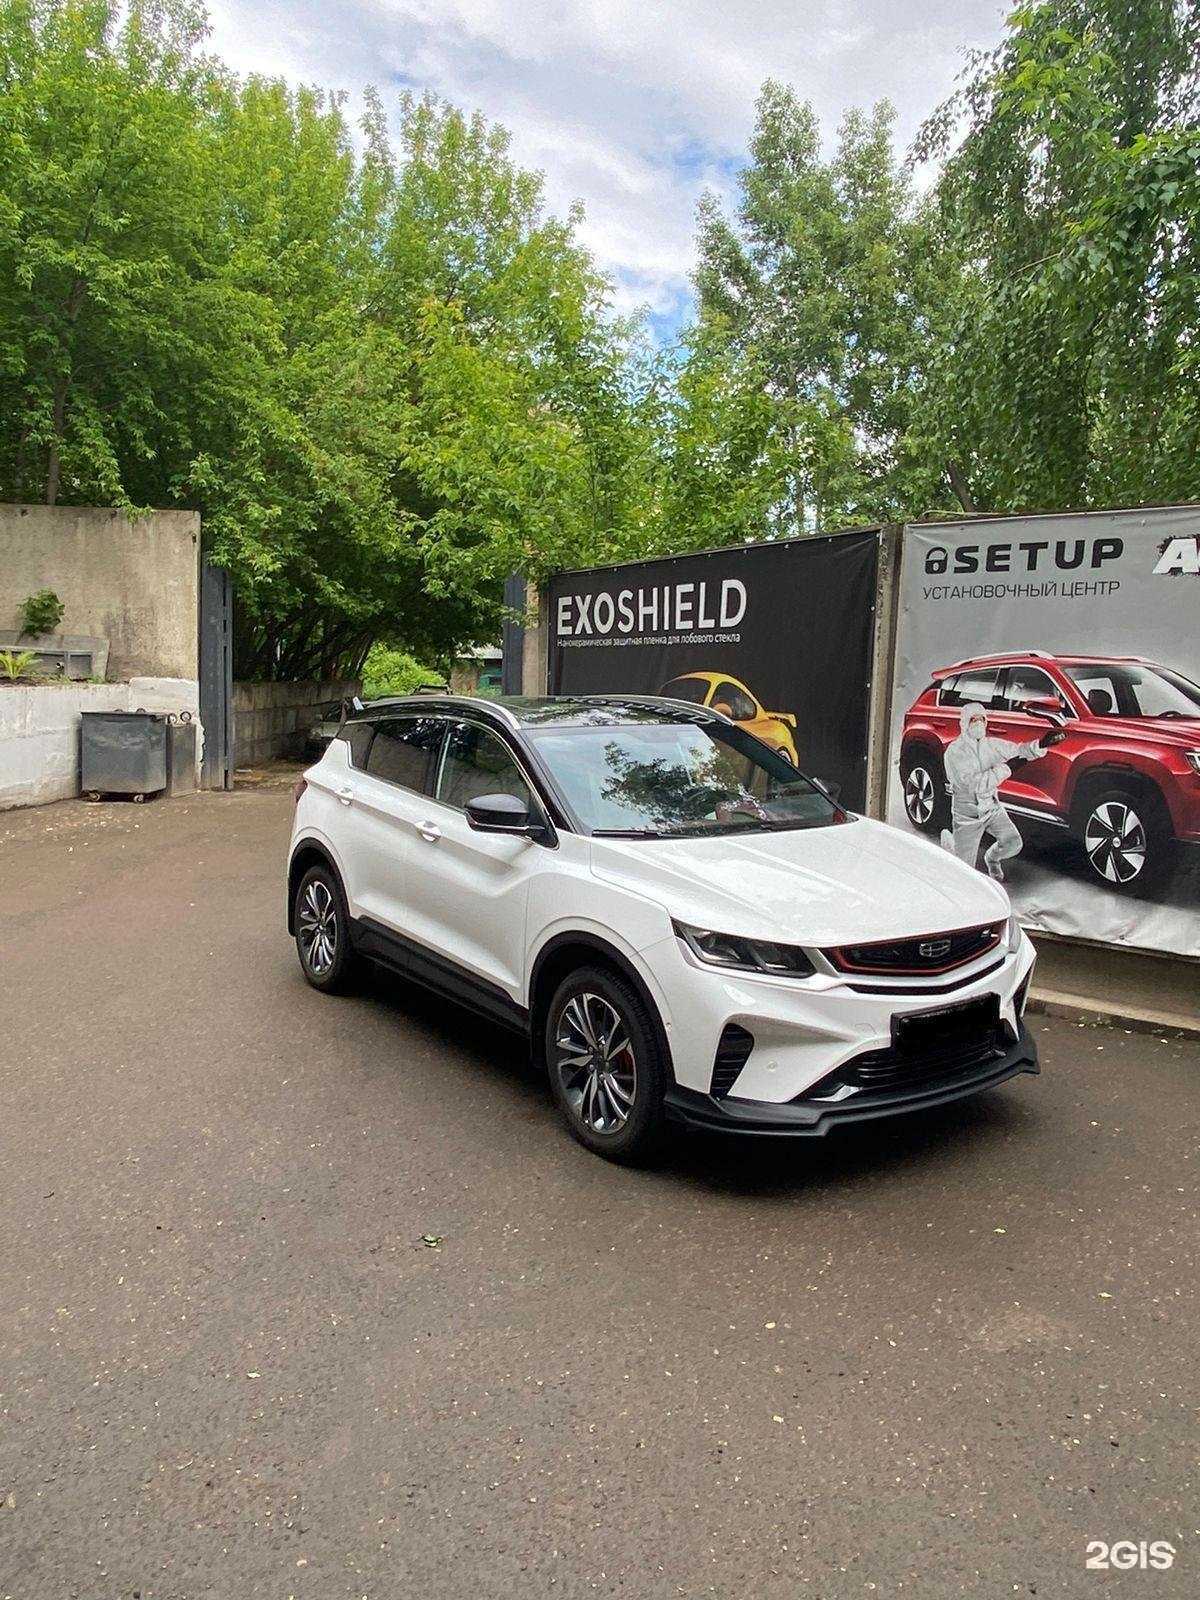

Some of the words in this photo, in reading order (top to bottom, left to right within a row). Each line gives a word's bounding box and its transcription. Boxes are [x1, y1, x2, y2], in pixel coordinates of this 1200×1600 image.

[953, 537, 1124, 574] SETUP
[1152, 538, 1200, 574] A
[557, 578, 747, 636] EXOSHIELD
[923, 581, 1056, 600] УСТАНОВОЧНЫЙ
[1062, 580, 1120, 598] ЦЕНТР
[681, 632, 714, 644] лобового
[714, 633, 740, 643] стекла
